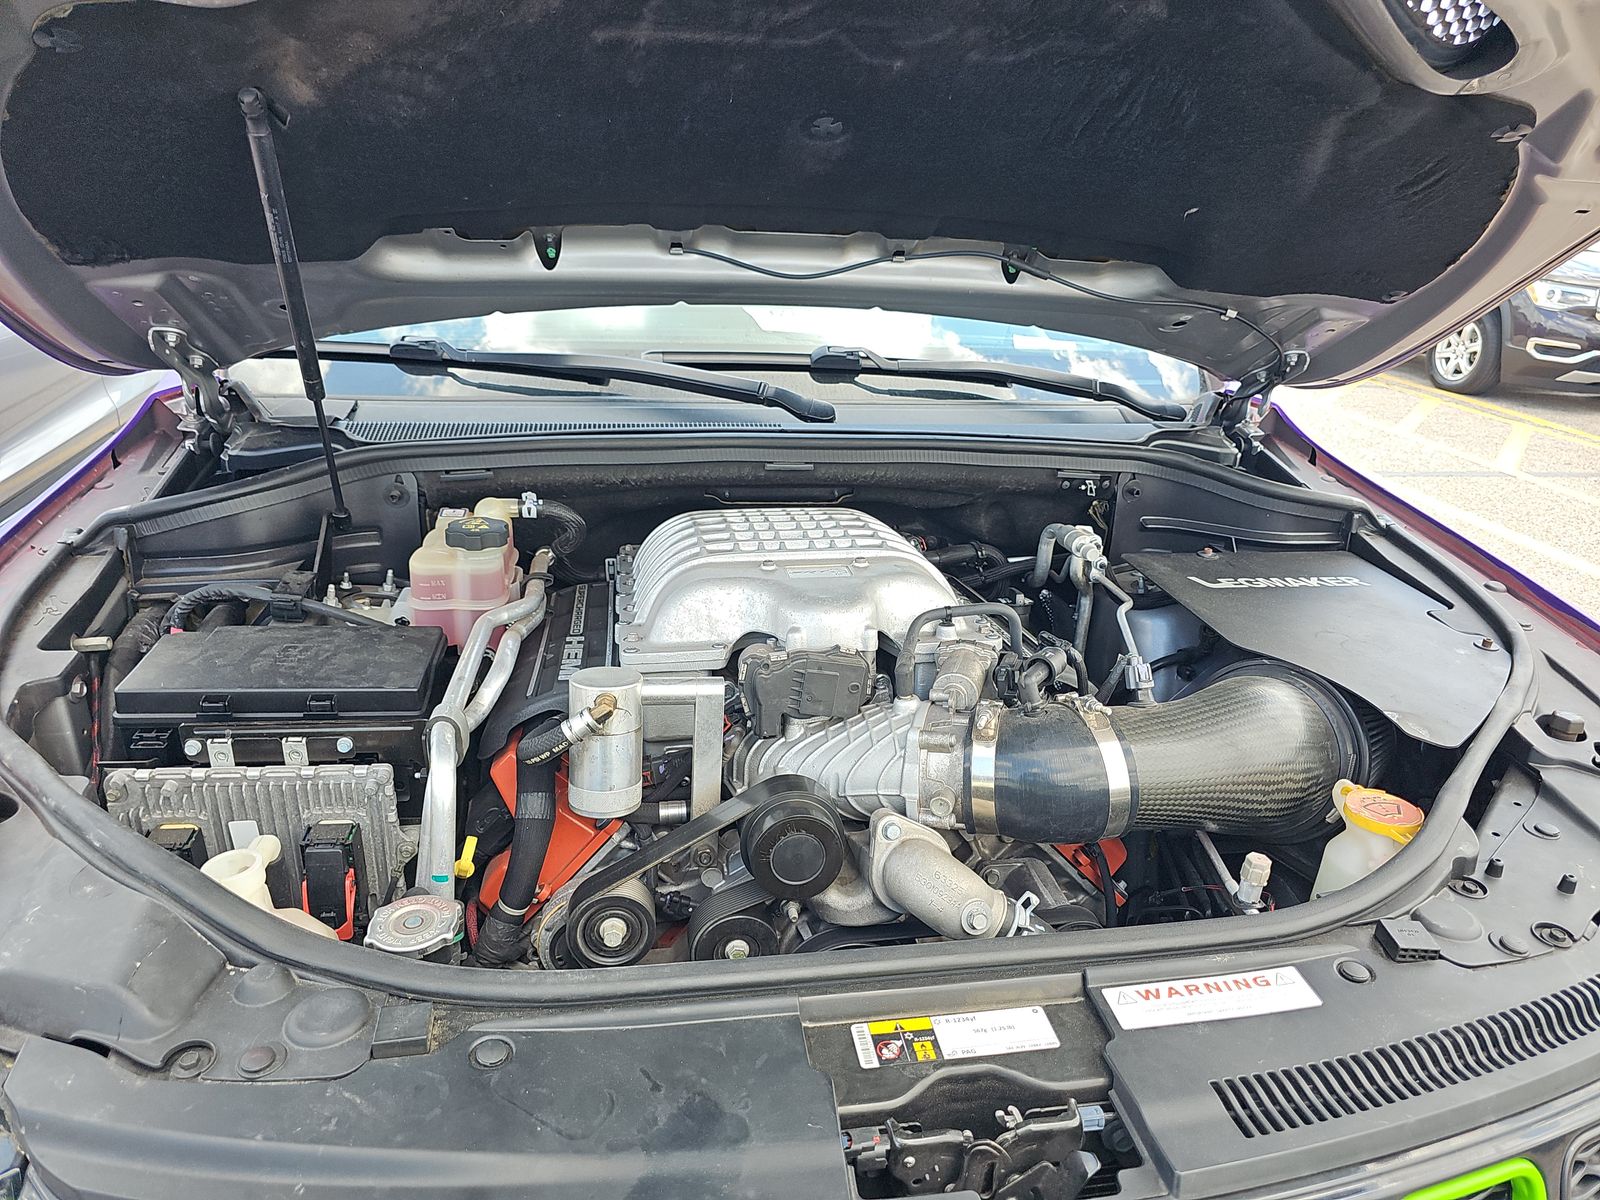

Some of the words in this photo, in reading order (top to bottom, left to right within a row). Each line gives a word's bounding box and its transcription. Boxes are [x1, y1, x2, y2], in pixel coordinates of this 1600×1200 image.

[1187, 576, 1371, 589] LEGMAKER
[572, 583, 587, 634] SUPERCHARGED
[1135, 975, 1272, 1001] WARNING
[961, 1048, 977, 1056] PAG
